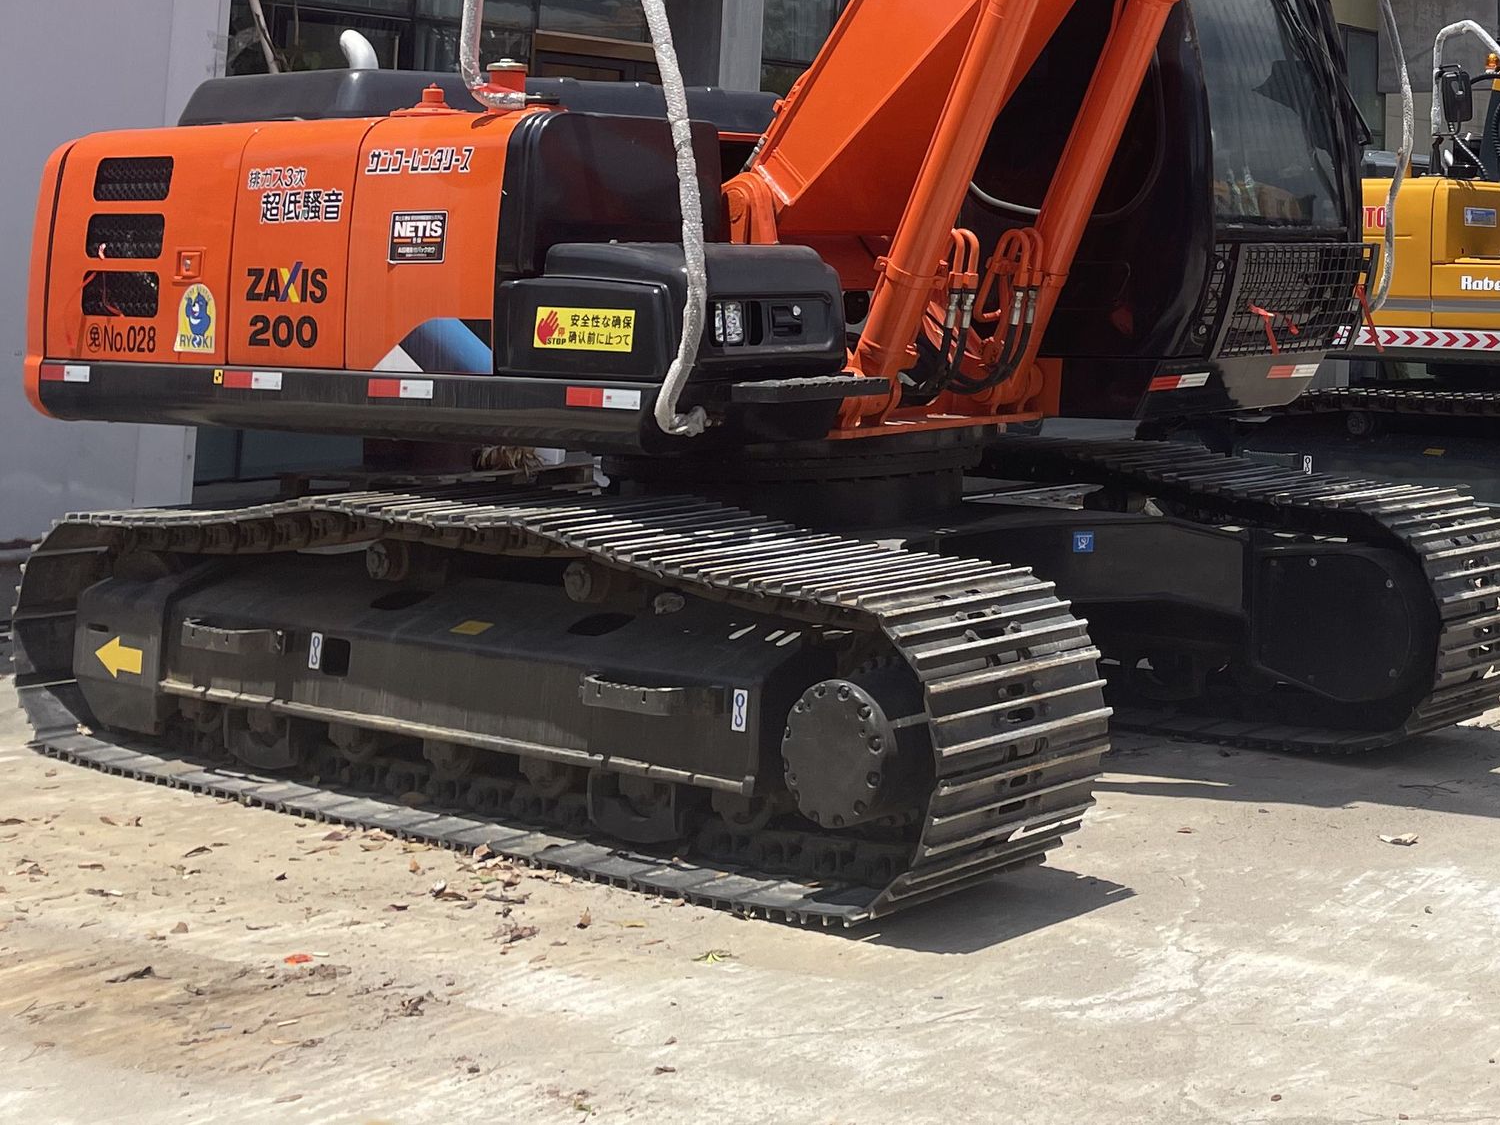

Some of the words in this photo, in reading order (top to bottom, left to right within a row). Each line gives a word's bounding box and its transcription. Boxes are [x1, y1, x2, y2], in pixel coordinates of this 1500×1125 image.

[366, 148, 473, 174] サンコーレンタリース
[248, 168, 307, 188] 排ガス3次
[260, 189, 343, 222] 超低騒音
[393, 220, 443, 237] NETIS
[246, 261, 328, 304] ZAXIS
[248, 315, 318, 348] 200
[547, 337, 567, 346] STOP
